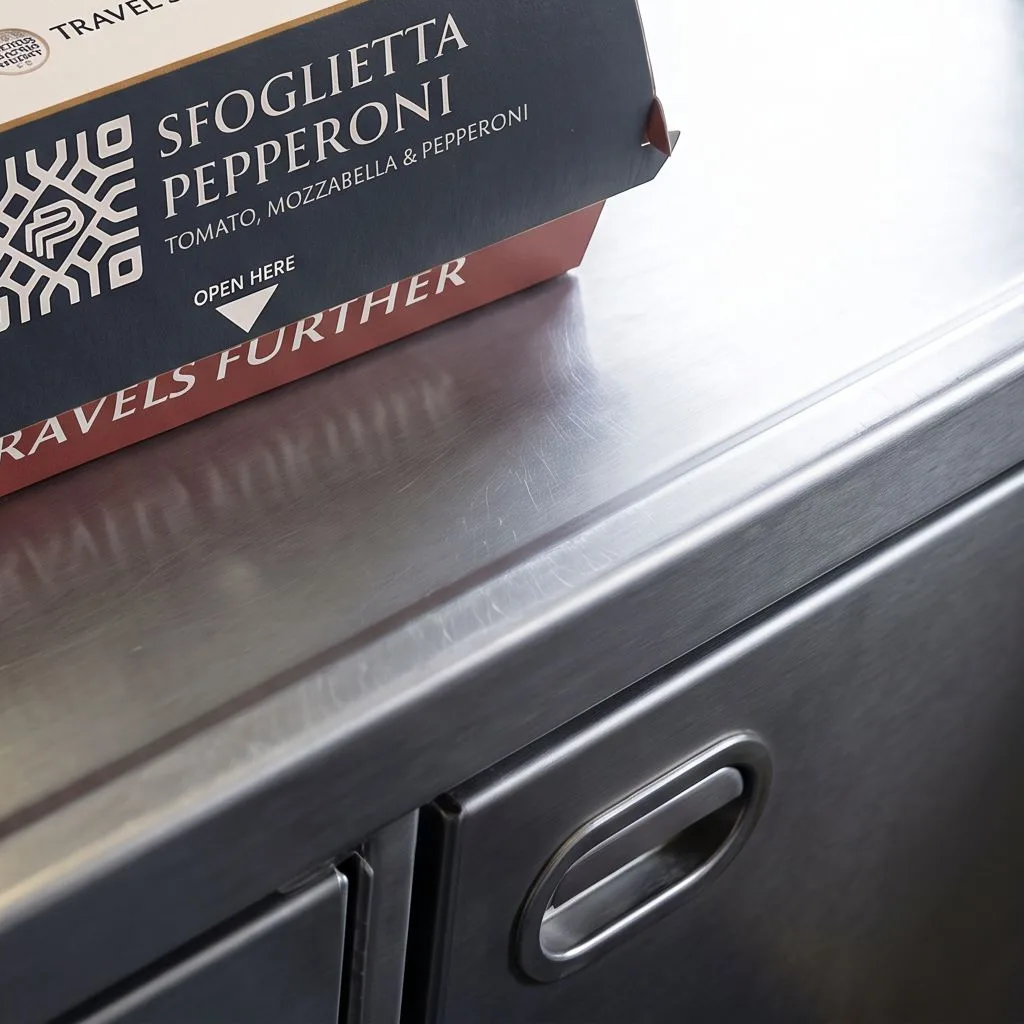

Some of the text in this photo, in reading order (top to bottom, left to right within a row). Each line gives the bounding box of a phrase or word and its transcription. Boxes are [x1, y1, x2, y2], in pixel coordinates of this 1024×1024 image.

[159, 13, 468, 157] SFOGLIETTA
[163, 74, 451, 218] PEPPERONI
[164, 208, 261, 254] TOMATO,
[404, 149, 417, 165] &
[423, 104, 527, 158] PEPPERONI
[194, 255, 295, 306] OPEN HERE
[217, 256, 465, 380] FURTHER
